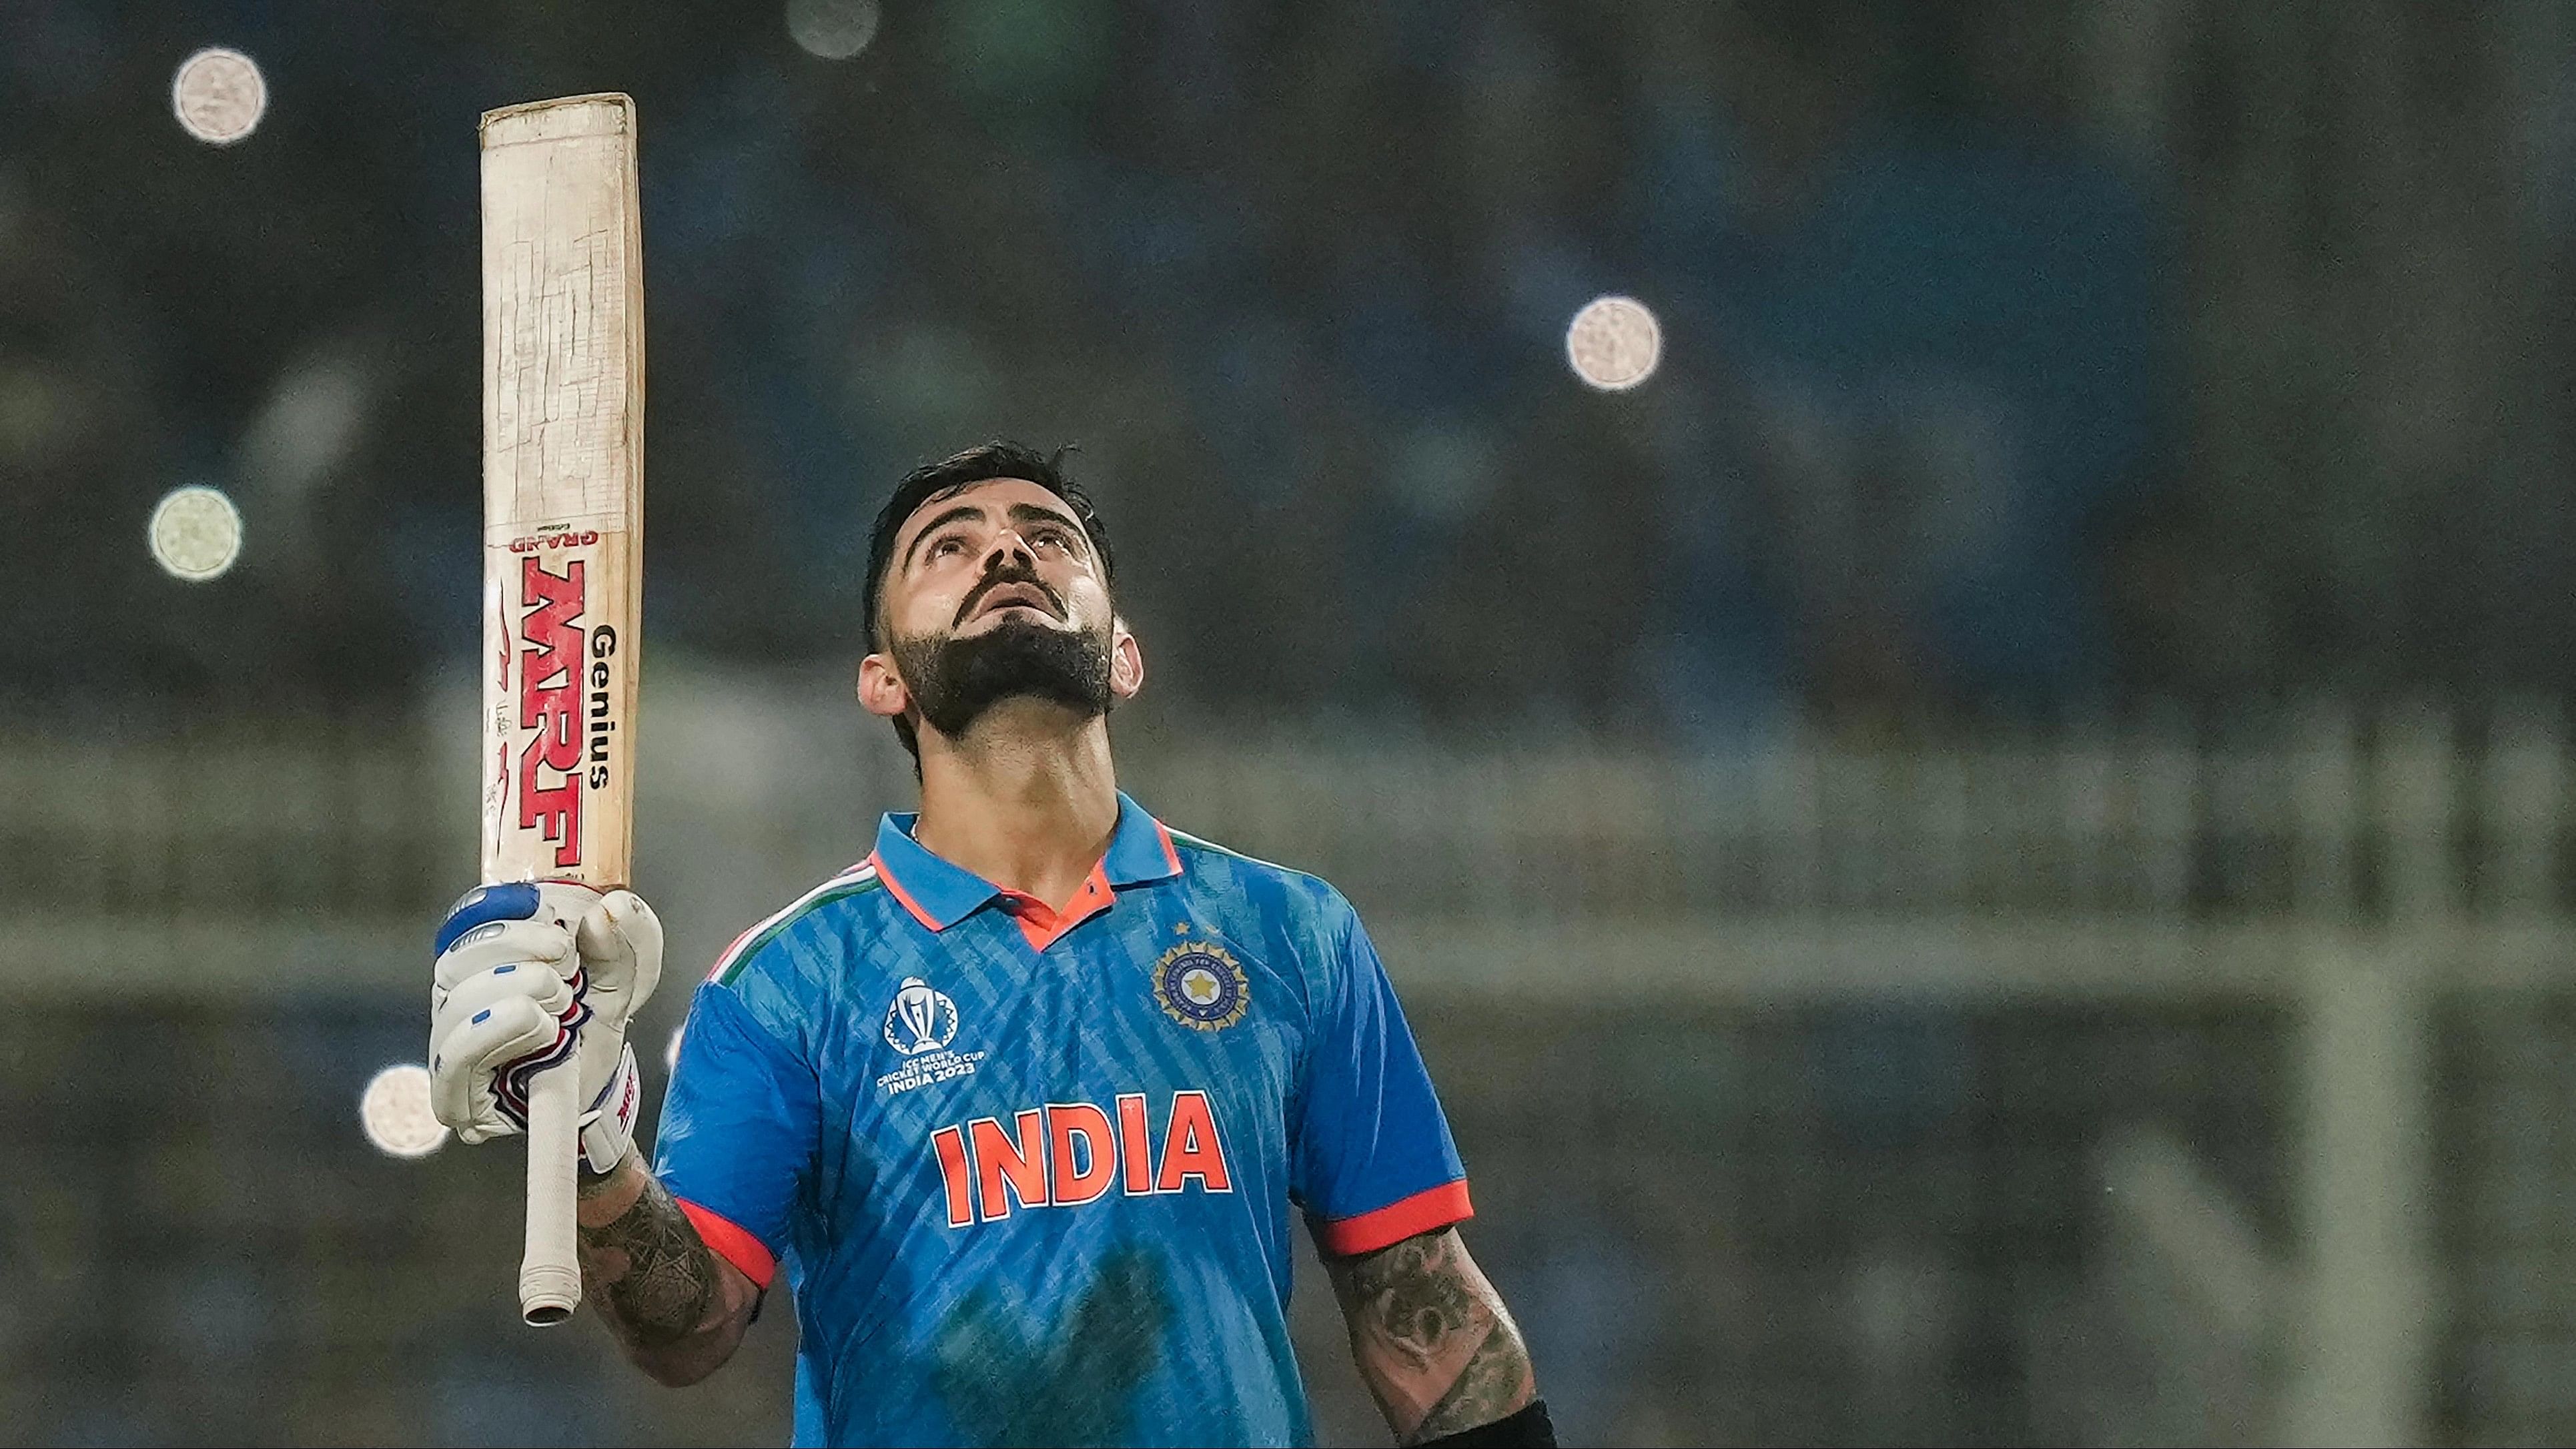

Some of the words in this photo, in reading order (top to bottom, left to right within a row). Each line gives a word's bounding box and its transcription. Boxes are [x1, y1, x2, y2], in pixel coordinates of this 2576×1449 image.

[509, 530, 598, 553] GRAND
[520, 556, 584, 868] MRF
[589, 624, 616, 790] Genius
[876, 1067, 920, 1087] CRICKET
[921, 1057, 962, 1073] WORLD
[962, 1051, 985, 1062] CUP
[888, 1072, 934, 1095] INDIA
[934, 1062, 975, 1083] 2023
[902, 1058, 919, 1070] ICC
[930, 1089, 1234, 1228] INDIA
